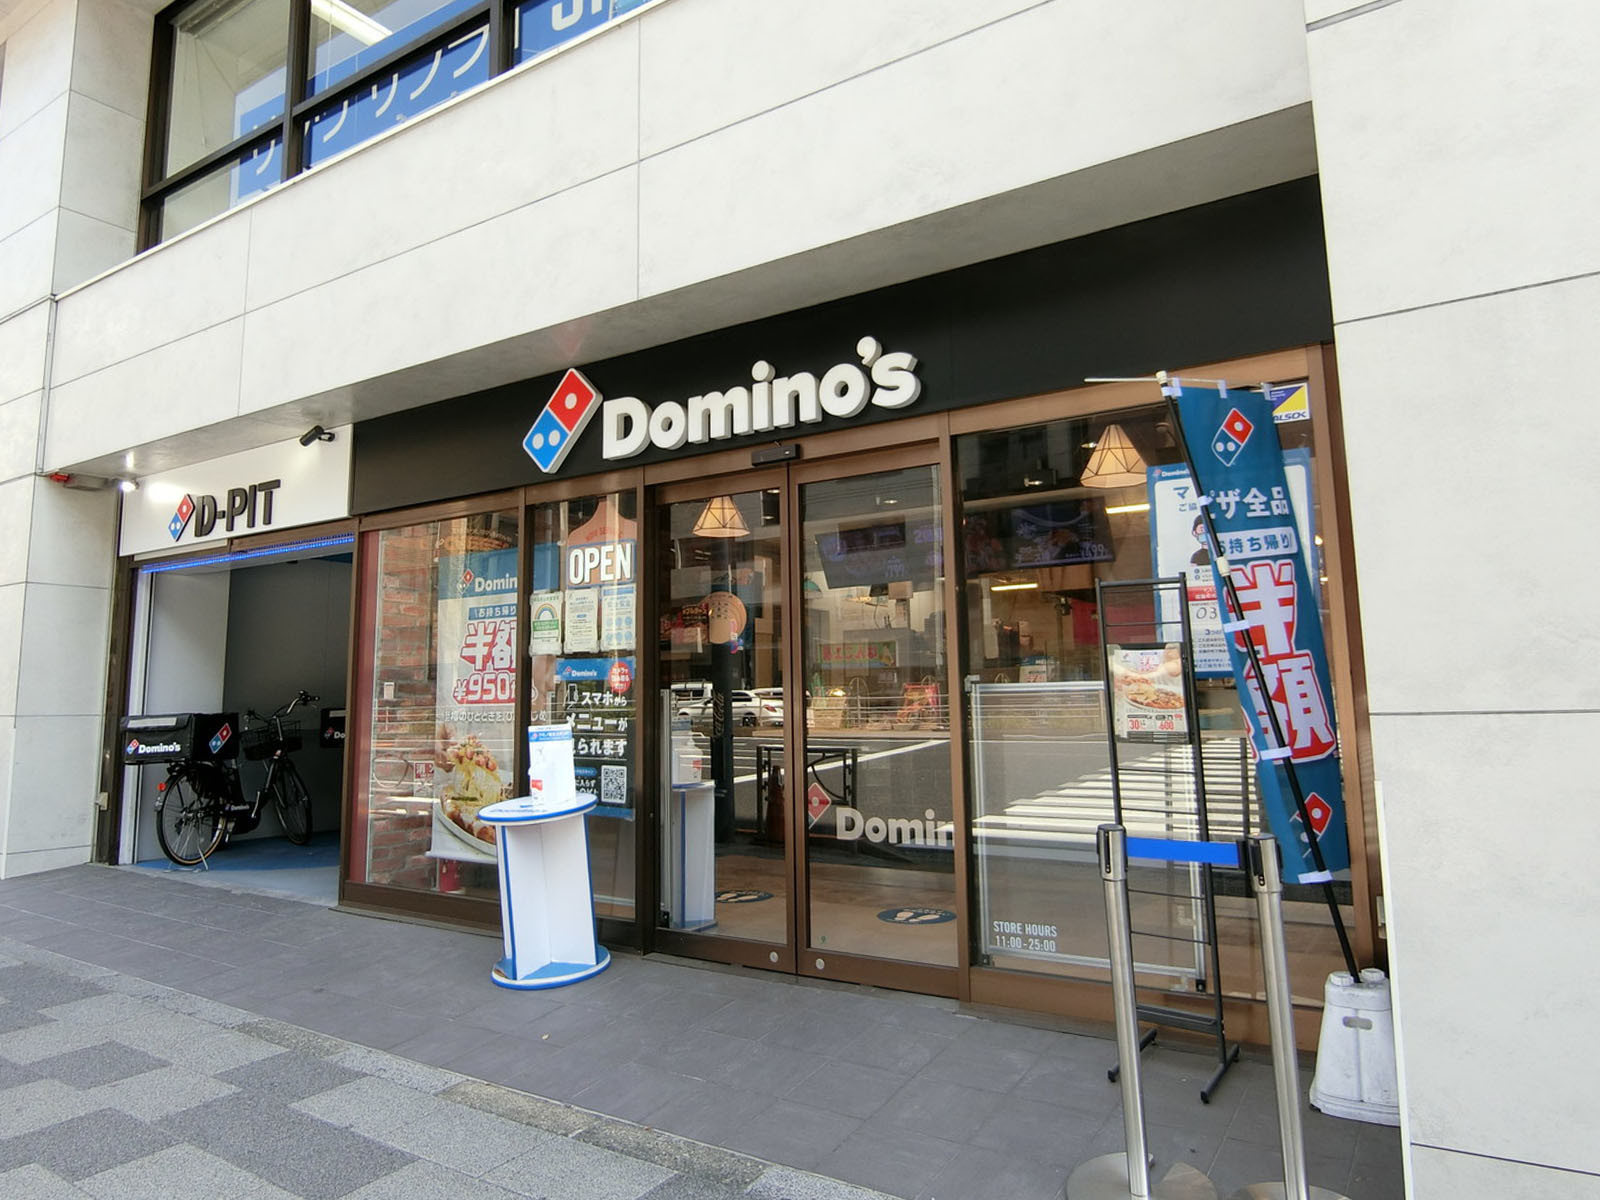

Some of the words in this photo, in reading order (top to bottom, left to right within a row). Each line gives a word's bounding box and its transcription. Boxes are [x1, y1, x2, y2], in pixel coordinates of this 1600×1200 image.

[603, 336, 922, 460] Domino's
[194, 480, 281, 538] D-PIT
[569, 544, 632, 585] OPEN
[581, 691, 628, 707] スマホから
[566, 712, 628, 732] メニューが
[138, 742, 182, 754] Domino's
[572, 738, 628, 757] られます
[993, 921, 1023, 934] STORE
[1025, 924, 1058, 937] HOURS
